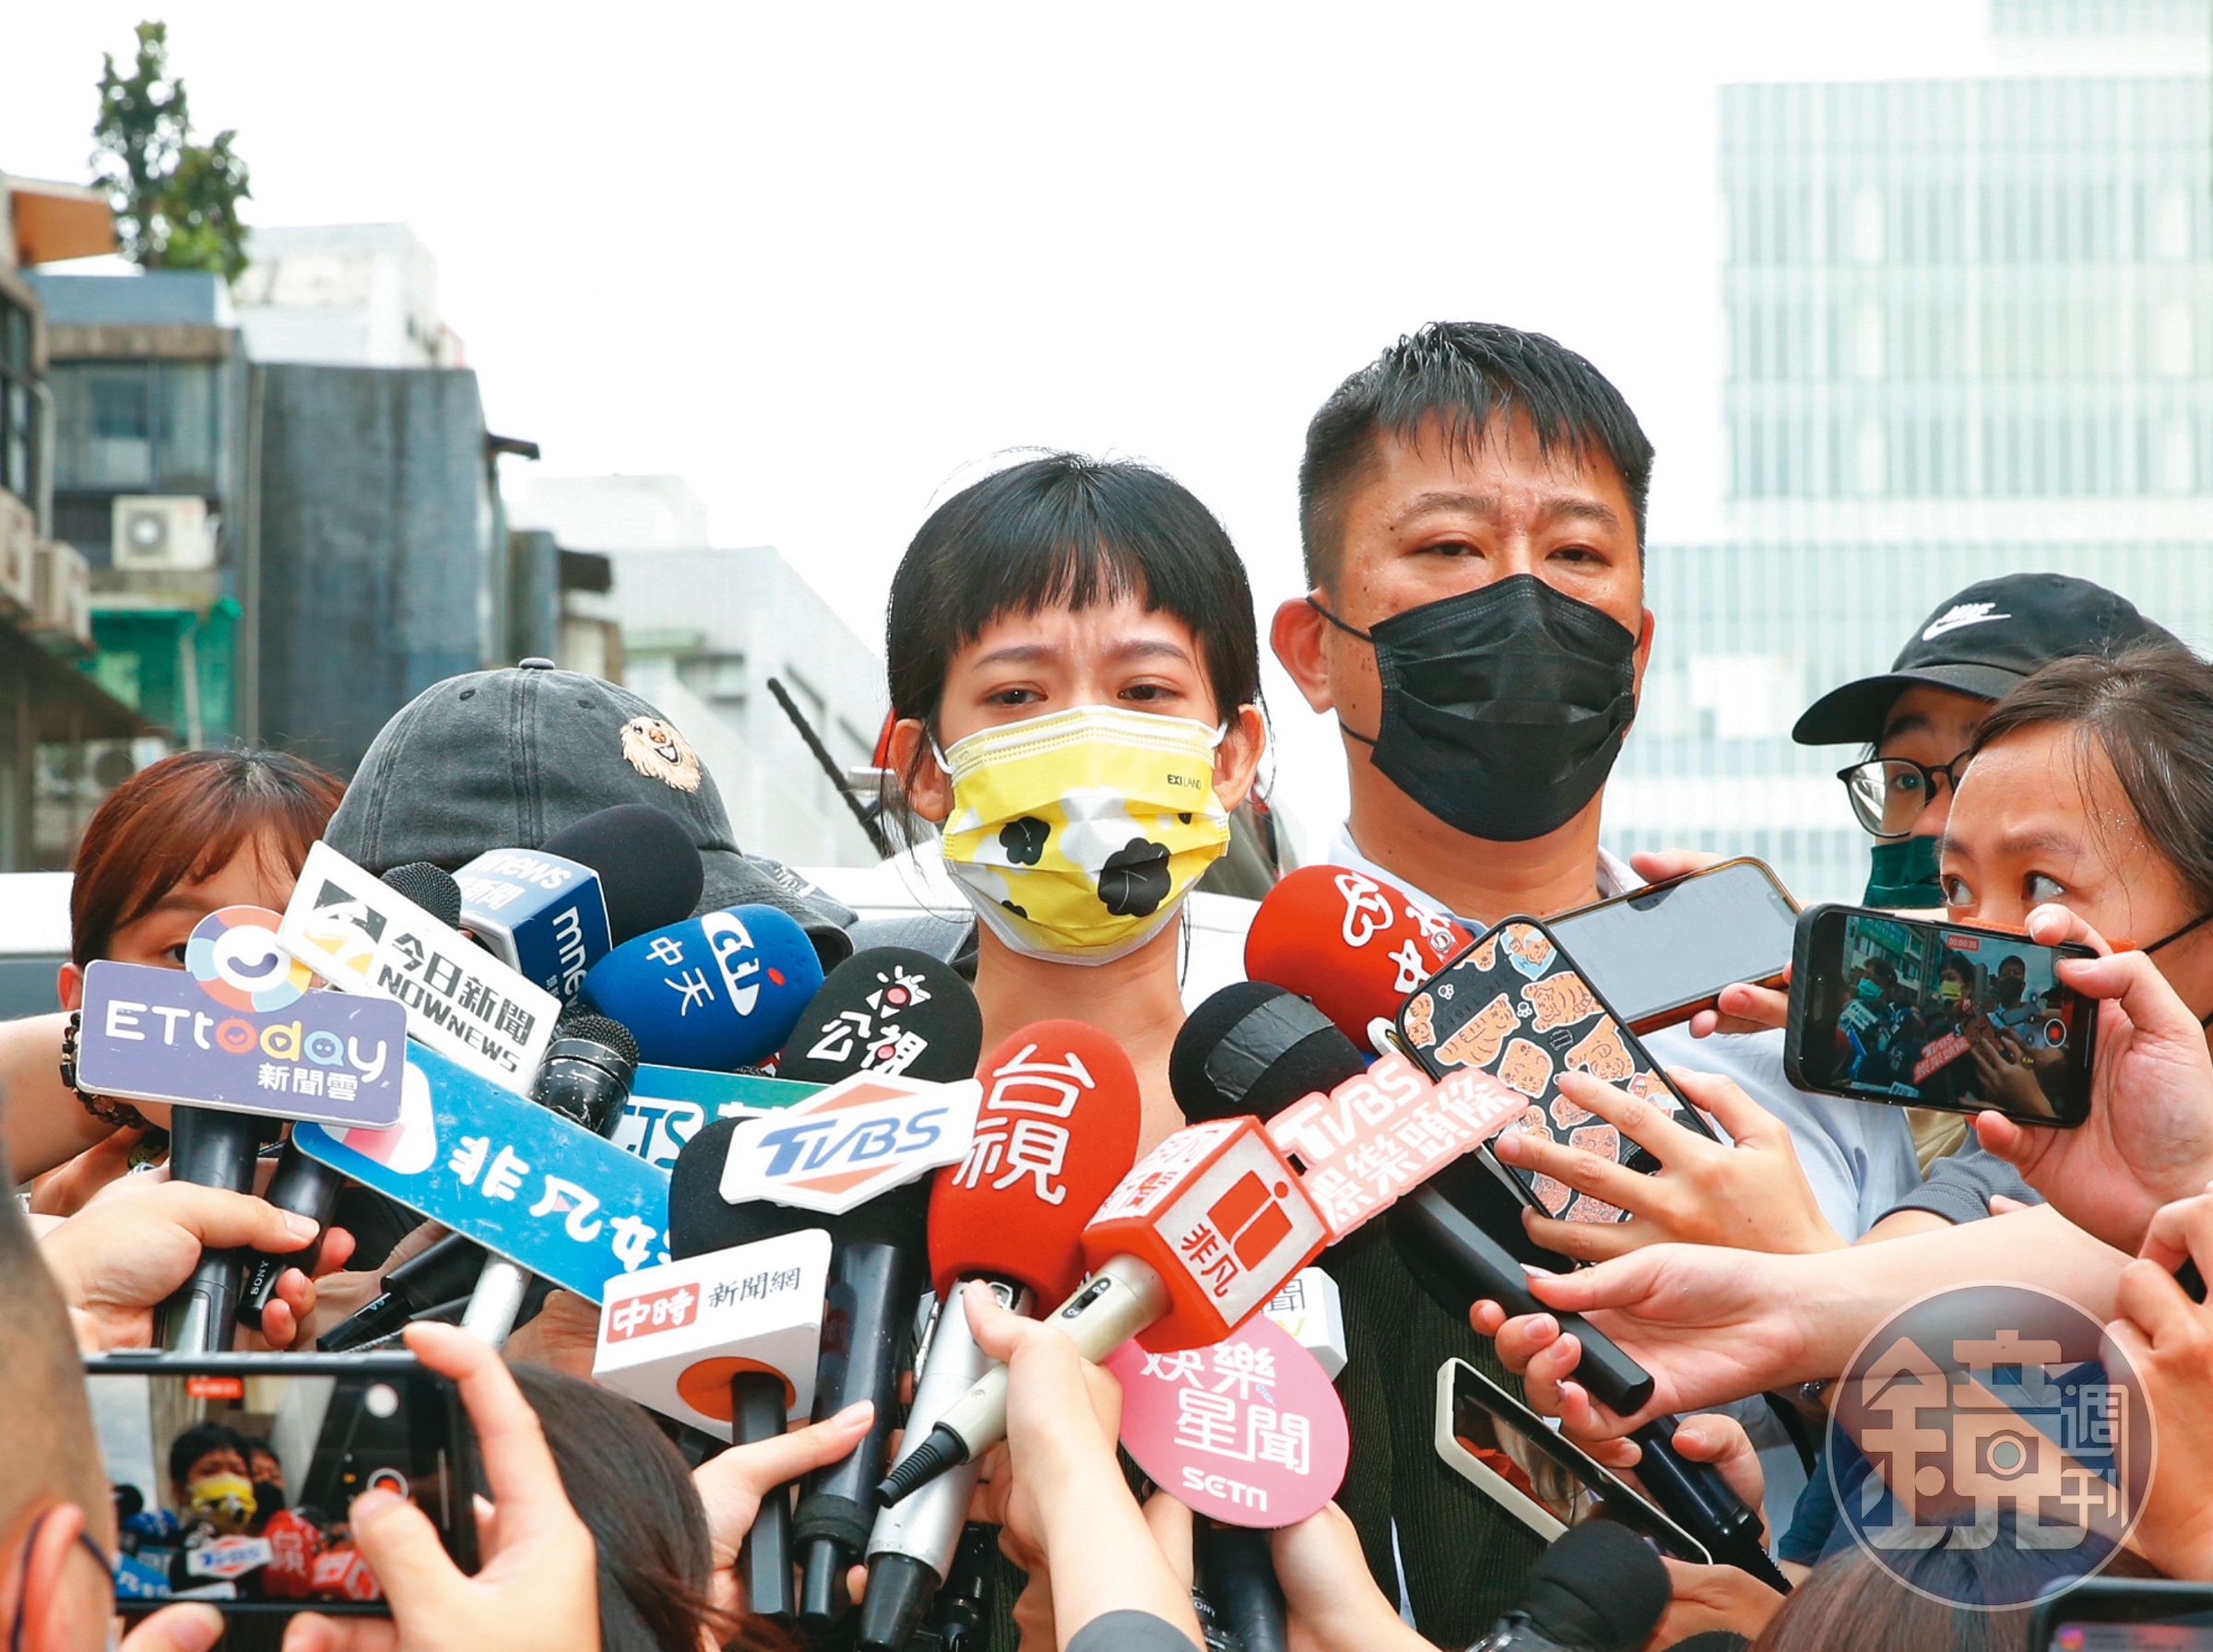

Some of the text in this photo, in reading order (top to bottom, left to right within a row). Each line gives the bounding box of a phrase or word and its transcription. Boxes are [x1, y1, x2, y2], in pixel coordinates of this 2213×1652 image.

[391, 932, 536, 1046] 今日新聞
[645, 936, 716, 1018] 中天
[105, 998, 387, 1084] ETtoday
[376, 963, 521, 1073] NOWNEWS
[256, 1062, 358, 1102] 新聞雲
[1272, 1060, 1423, 1161] TVBS
[756, 1106, 951, 1178] TVBS
[250, 1259, 270, 1296] SONY
[1181, 1222, 1239, 1298] 非凡
[611, 1266, 802, 1339] 中時 新聞網
[1173, 1386, 1310, 1476] 星聞
[1181, 1465, 1268, 1513] SETN
[1193, 1600, 1216, 1618] ONY
